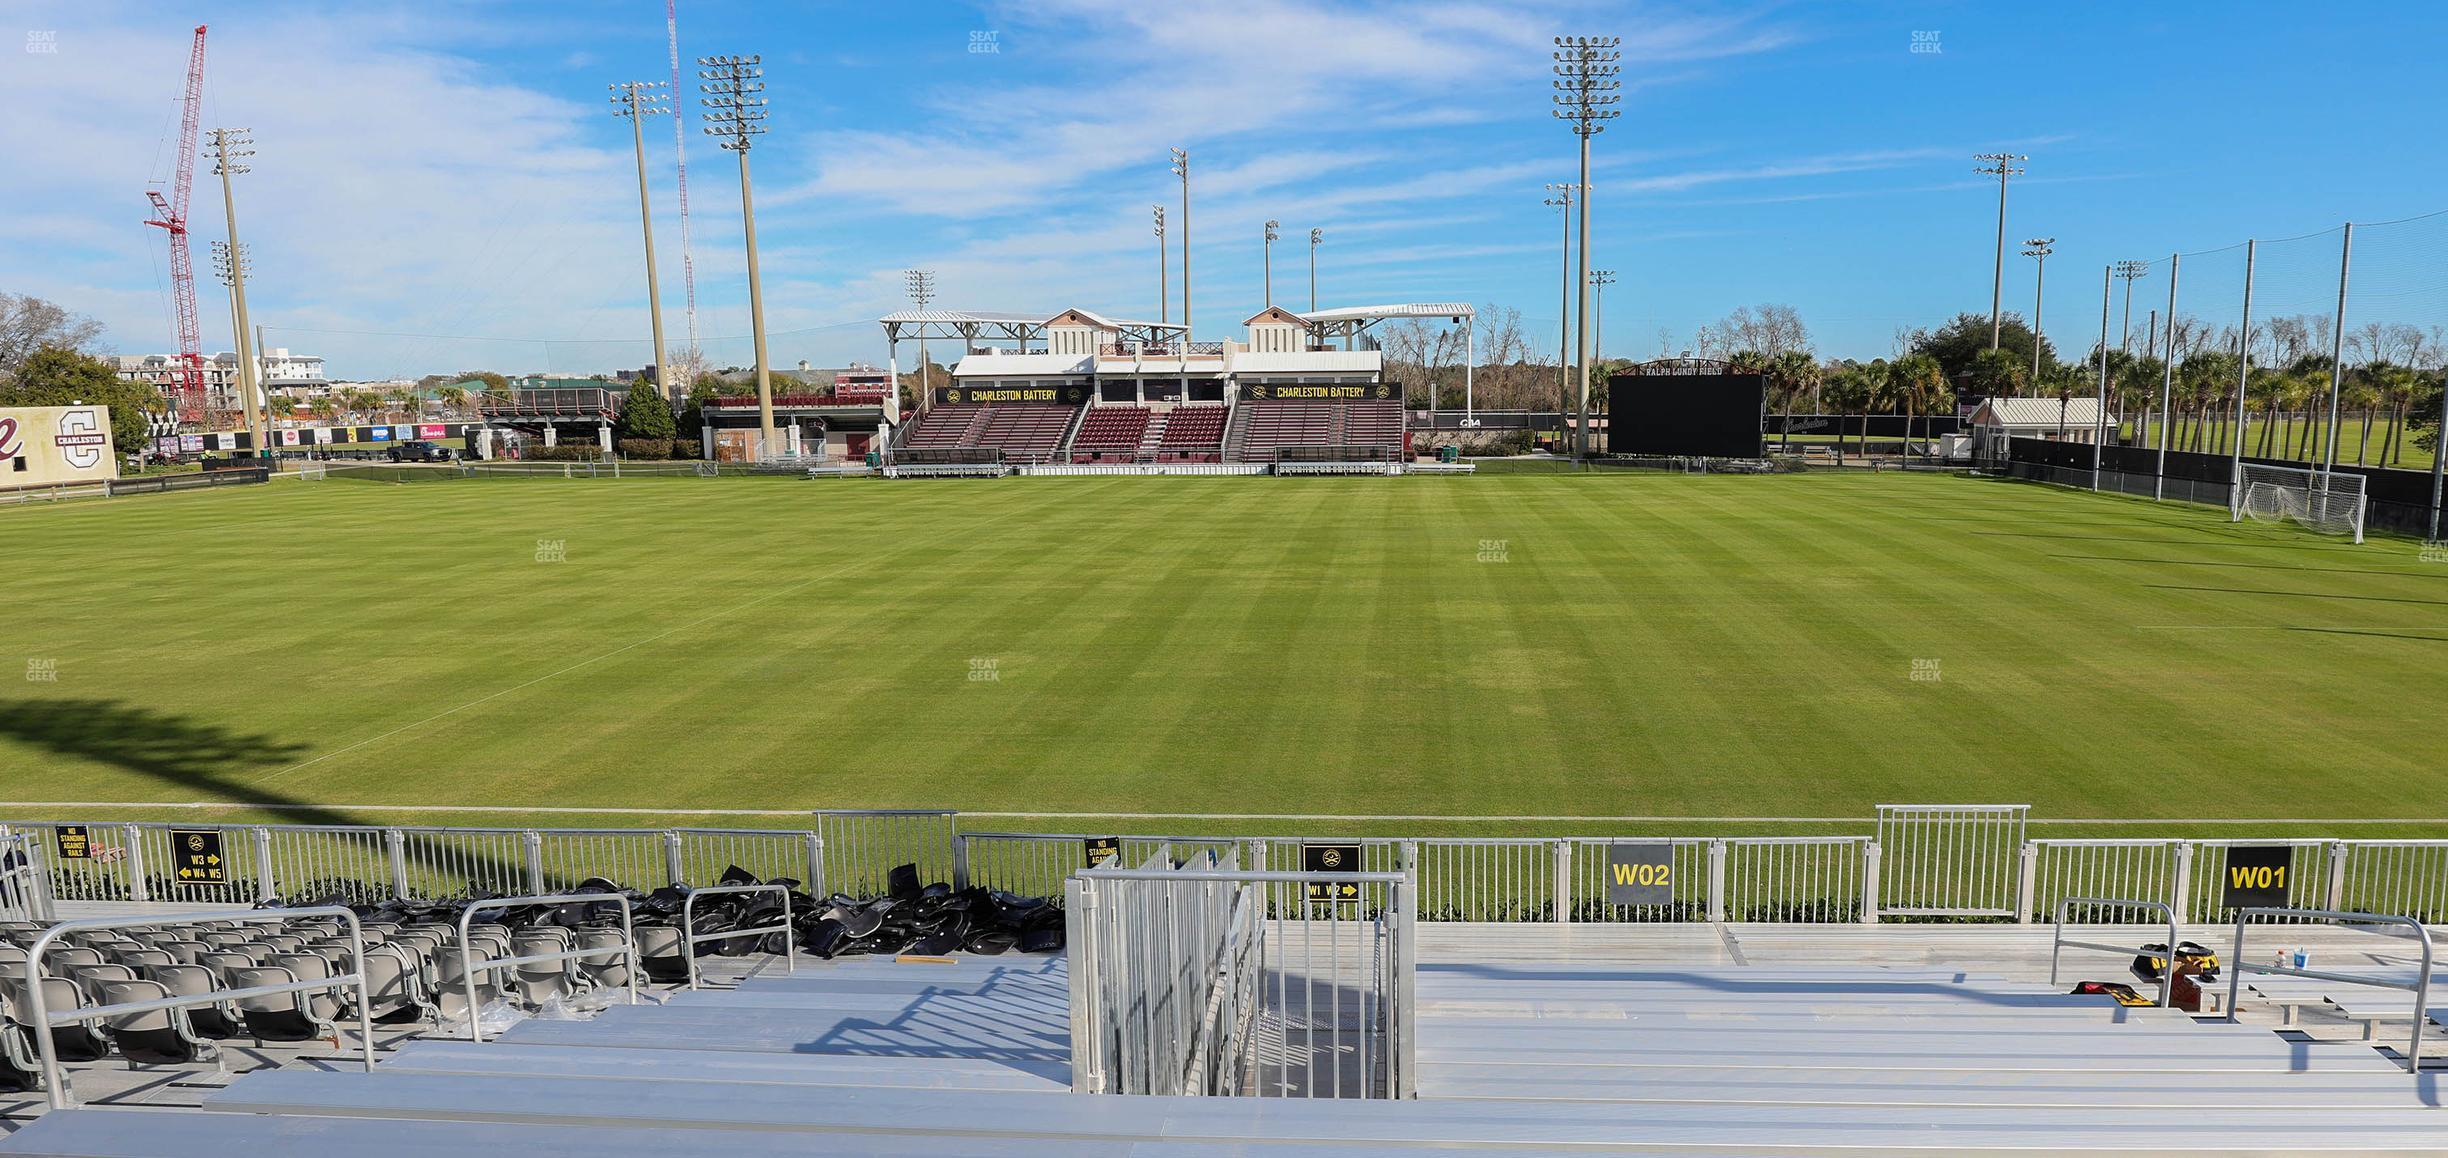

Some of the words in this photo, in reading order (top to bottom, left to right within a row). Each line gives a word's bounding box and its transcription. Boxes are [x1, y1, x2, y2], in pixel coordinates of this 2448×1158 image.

[1646, 368, 1671, 376] RALPH
[1672, 368, 1697, 376] LUNDY
[1699, 367, 1722, 376] FIELD
[971, 390, 1023, 401] CHARLESTON
[1023, 389, 1057, 400] BATTERY
[1276, 387, 1328, 398] CHARLESTON
[1330, 387, 1365, 397] BATTERY
[57, 436, 104, 445] CHARLESTON
[67, 827, 76, 835] NO
[60, 834, 86, 842] STANDING
[1097, 840, 1107, 848] NO
[67, 849, 84, 857] RAILS
[1088, 847, 1118, 857] STANDING
[191, 855, 205, 865] W3
[193, 868, 206, 878] W4
[209, 868, 222, 879] W5
[1612, 863, 1671, 886] W02
[2231, 866, 2285, 889] W01
[1309, 885, 1320, 896] W1
